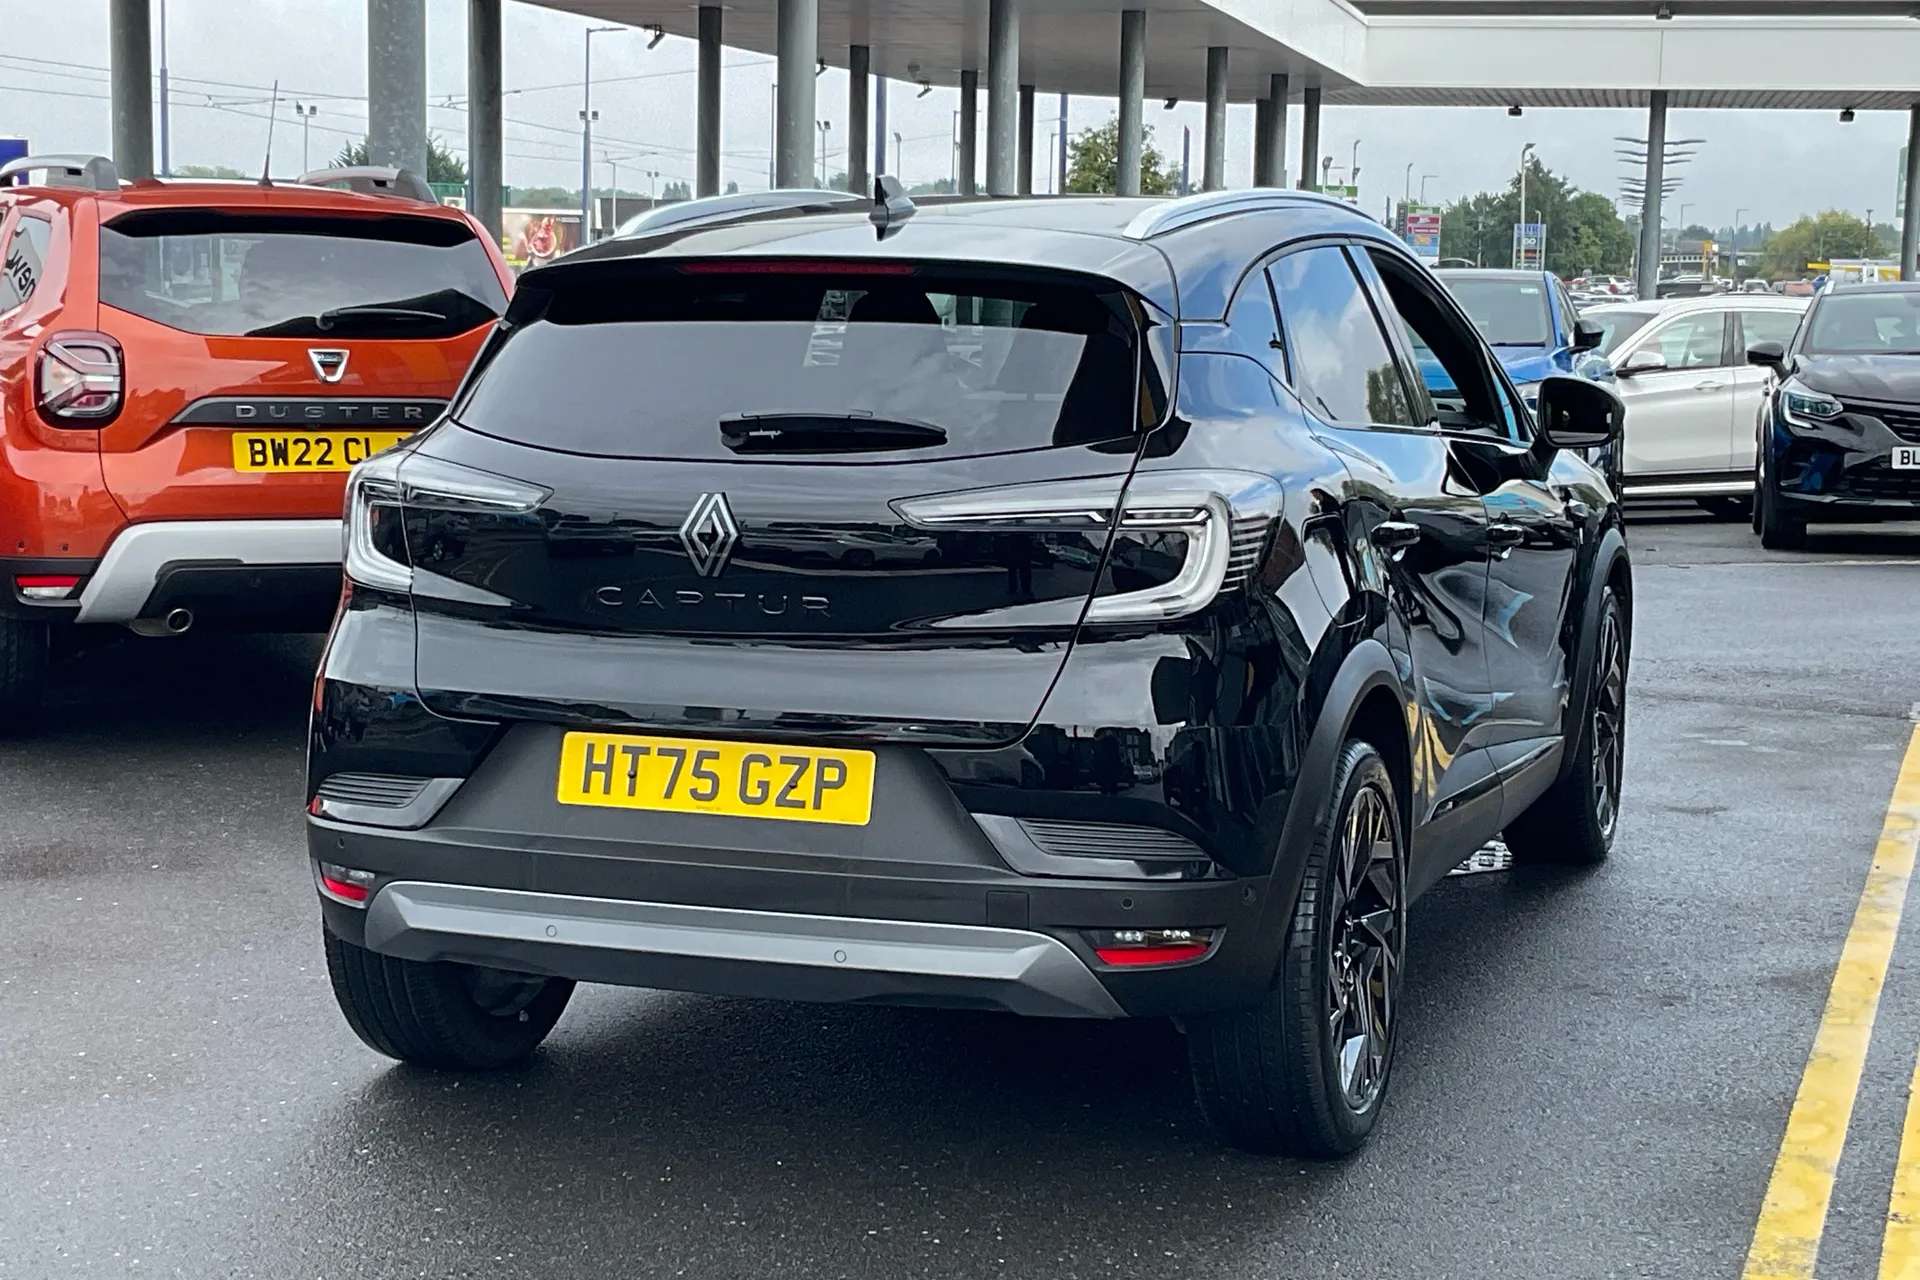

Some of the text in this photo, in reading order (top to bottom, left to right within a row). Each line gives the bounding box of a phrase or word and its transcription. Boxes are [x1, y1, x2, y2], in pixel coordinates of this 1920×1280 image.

[236, 405, 423, 419] DUSTER
[247, 437, 334, 467] BW22
[597, 586, 831, 618] CAPTUR
[582, 743, 848, 811] HT75 GZP
